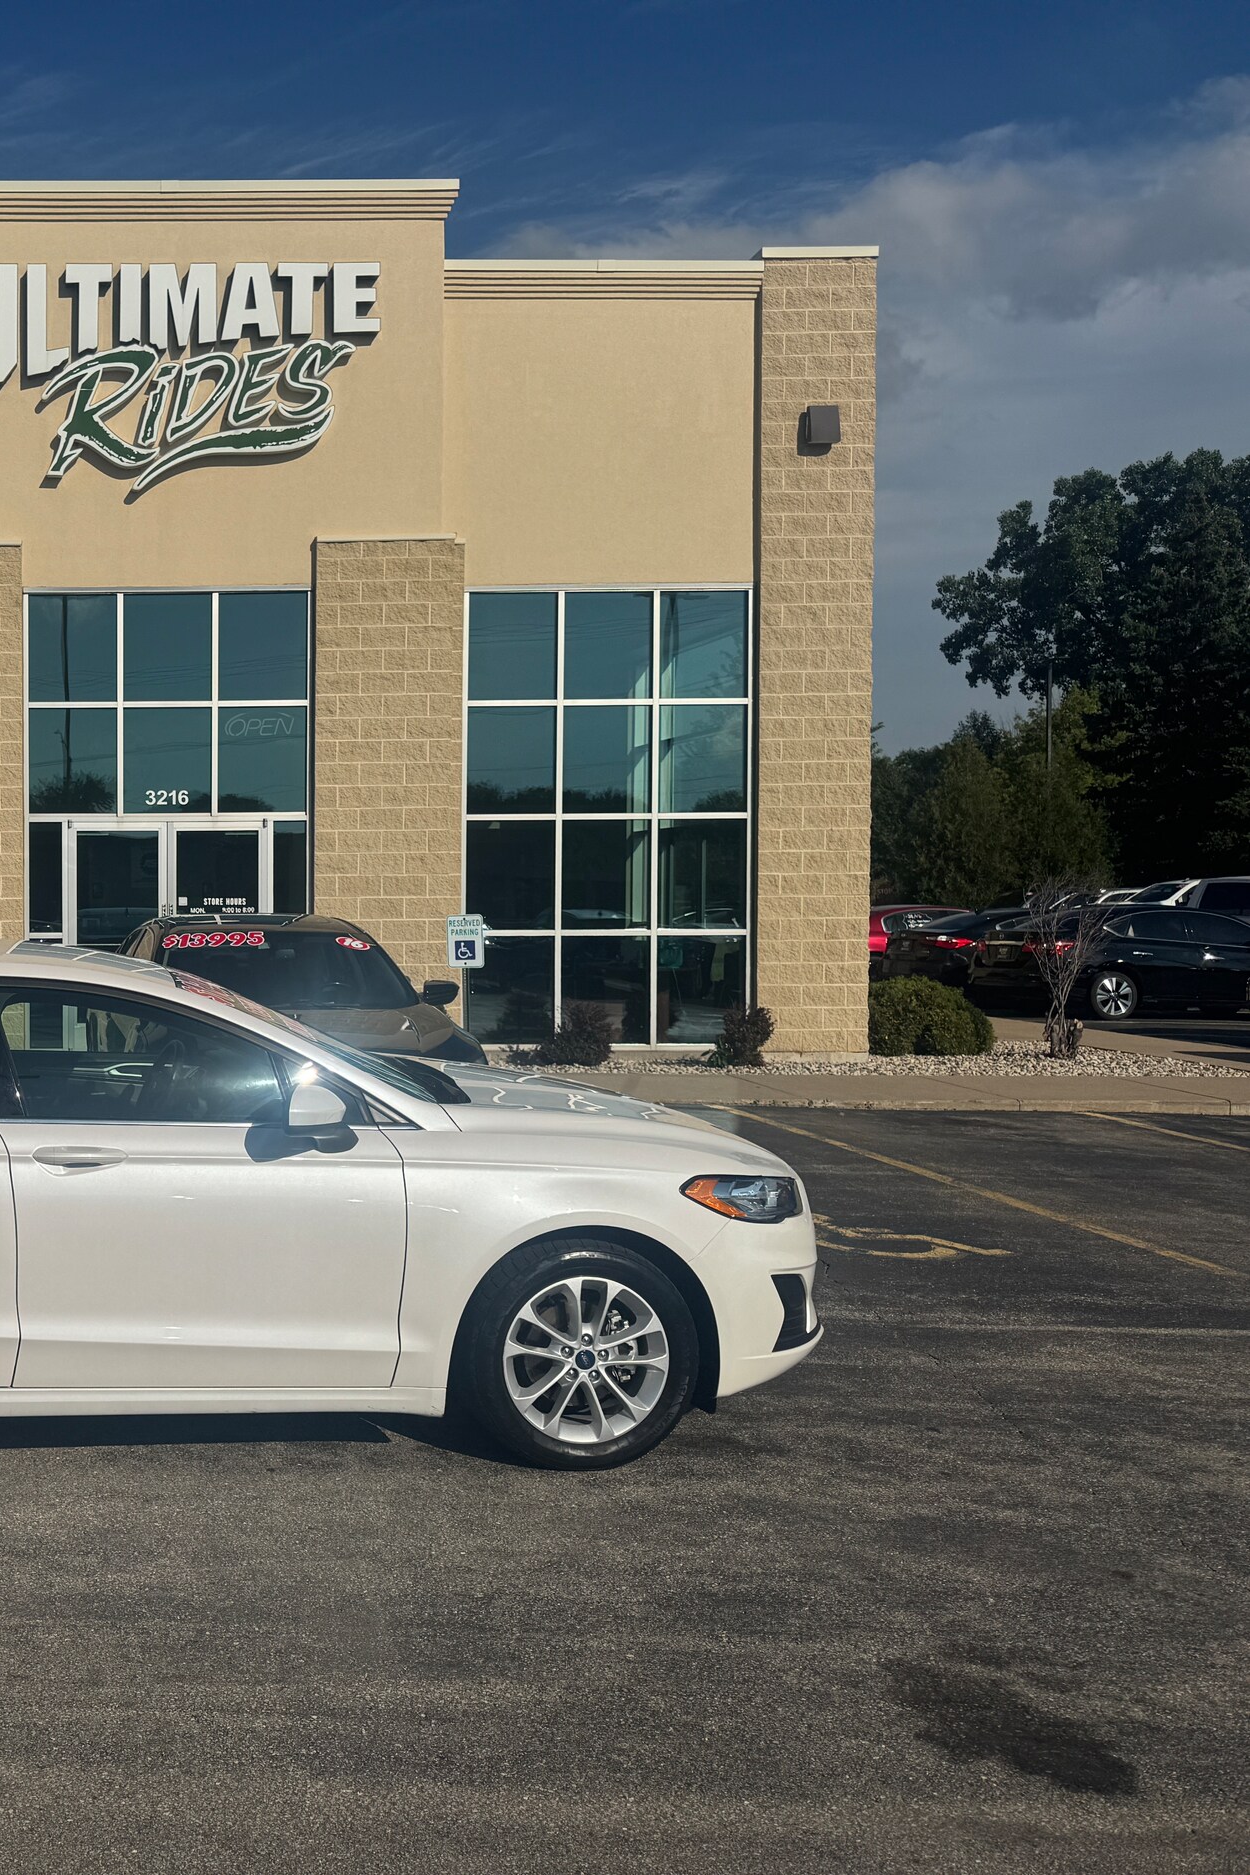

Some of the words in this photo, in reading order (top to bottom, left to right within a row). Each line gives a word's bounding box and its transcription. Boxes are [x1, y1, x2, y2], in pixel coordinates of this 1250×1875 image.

[228, 717, 295, 737] OPEN
[144, 789, 190, 806] 3216
[203, 897, 224, 906] STORE
[225, 897, 247, 906] HOURS
[448, 919, 481, 927] RESERVED
[450, 928, 479, 936] PARKING
[162, 930, 266, 949] $13995
